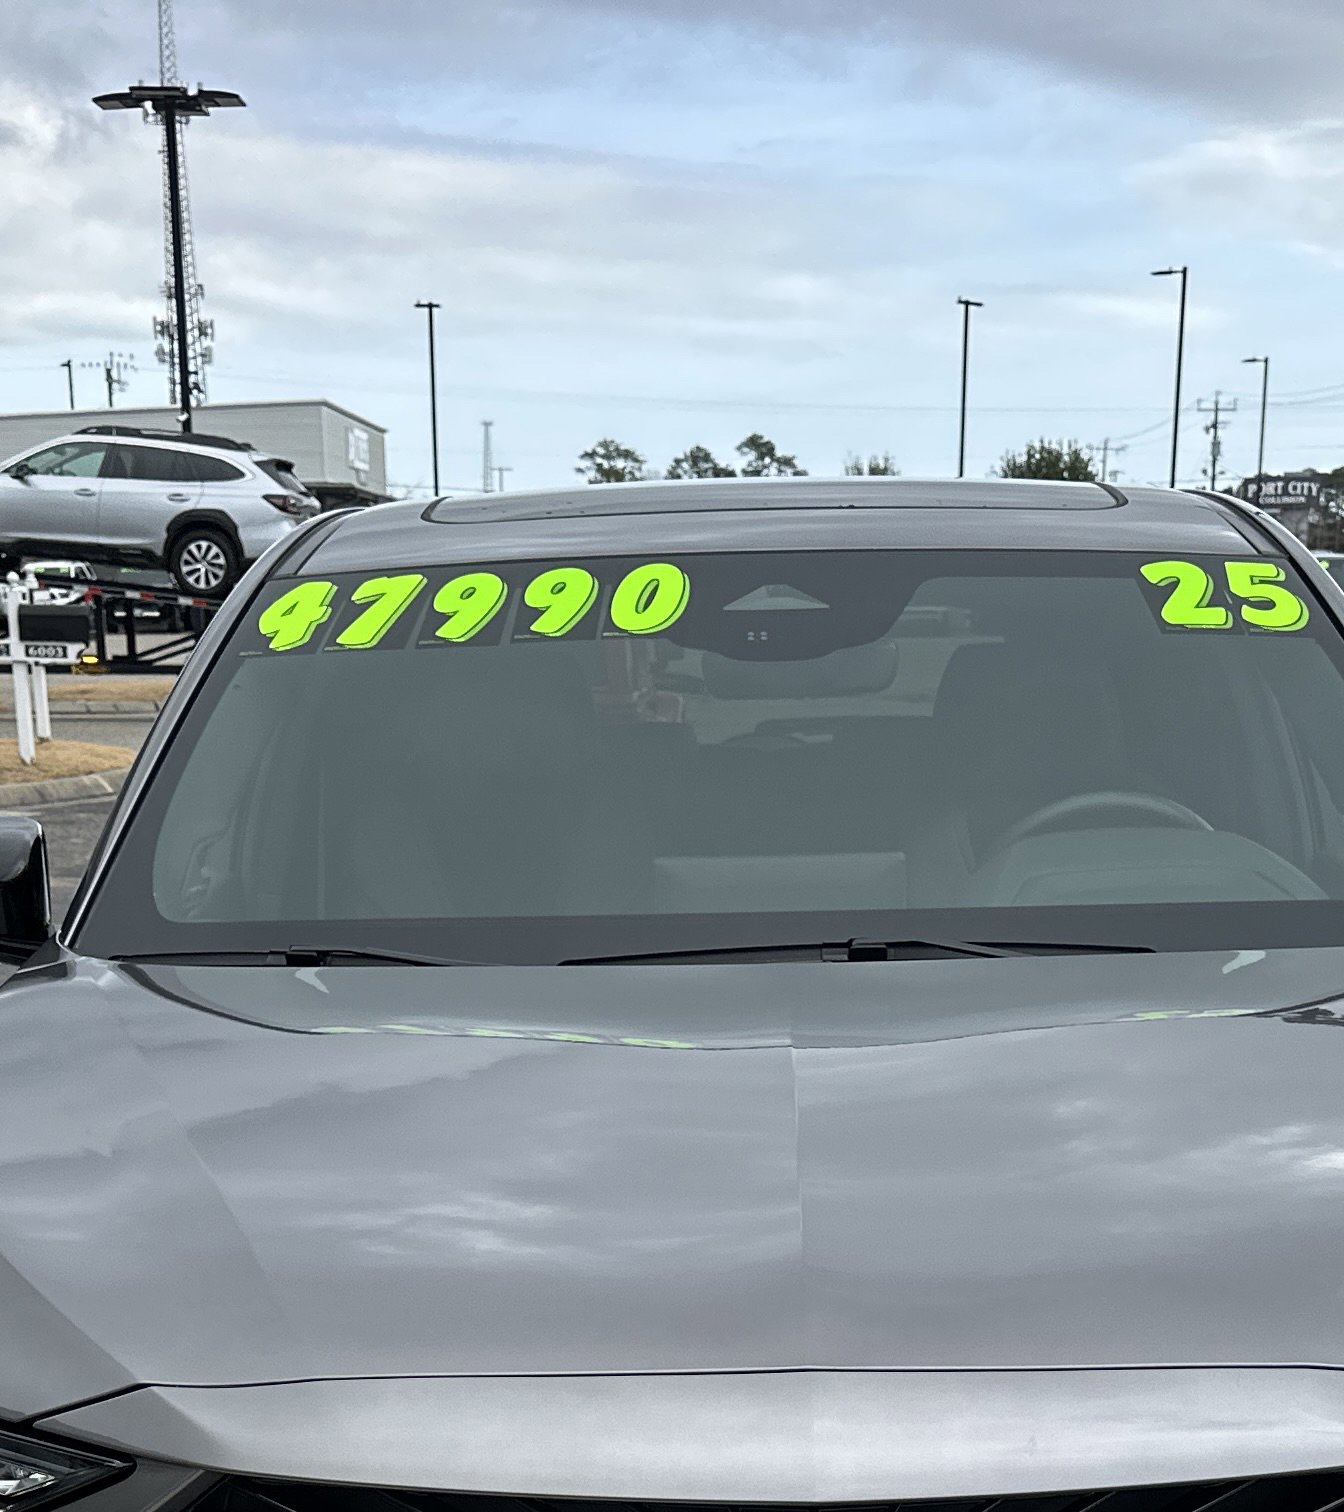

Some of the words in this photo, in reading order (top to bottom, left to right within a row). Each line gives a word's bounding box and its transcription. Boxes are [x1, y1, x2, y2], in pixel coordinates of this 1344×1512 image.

[1288, 480, 1320, 496] CITY
[258, 563, 690, 651] 47990
[1139, 560, 1309, 632] 25
